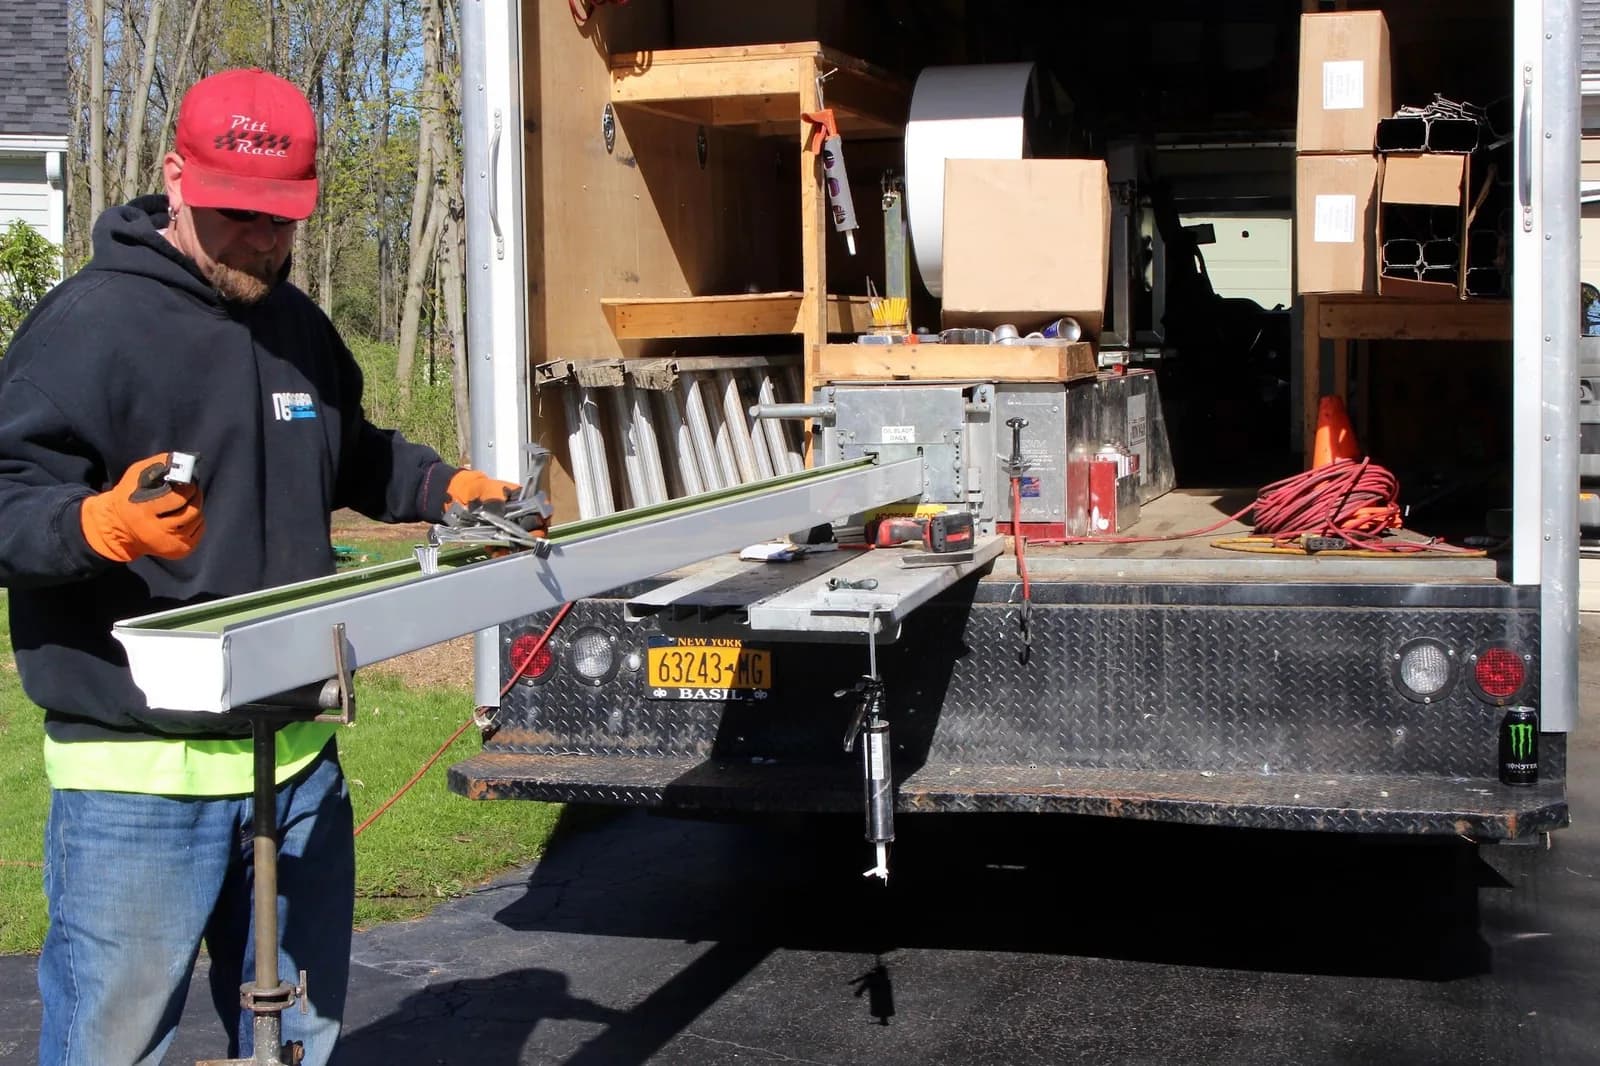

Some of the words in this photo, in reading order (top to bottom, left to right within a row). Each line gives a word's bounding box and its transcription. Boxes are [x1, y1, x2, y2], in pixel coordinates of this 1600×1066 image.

[231, 114, 268, 132] Pitt
[237, 139, 288, 157] Race
[678, 638, 707, 646] NEW
[711, 638, 742, 647] YORK
[659, 651, 722, 683] 63243
[679, 688, 743, 700] BASIL
